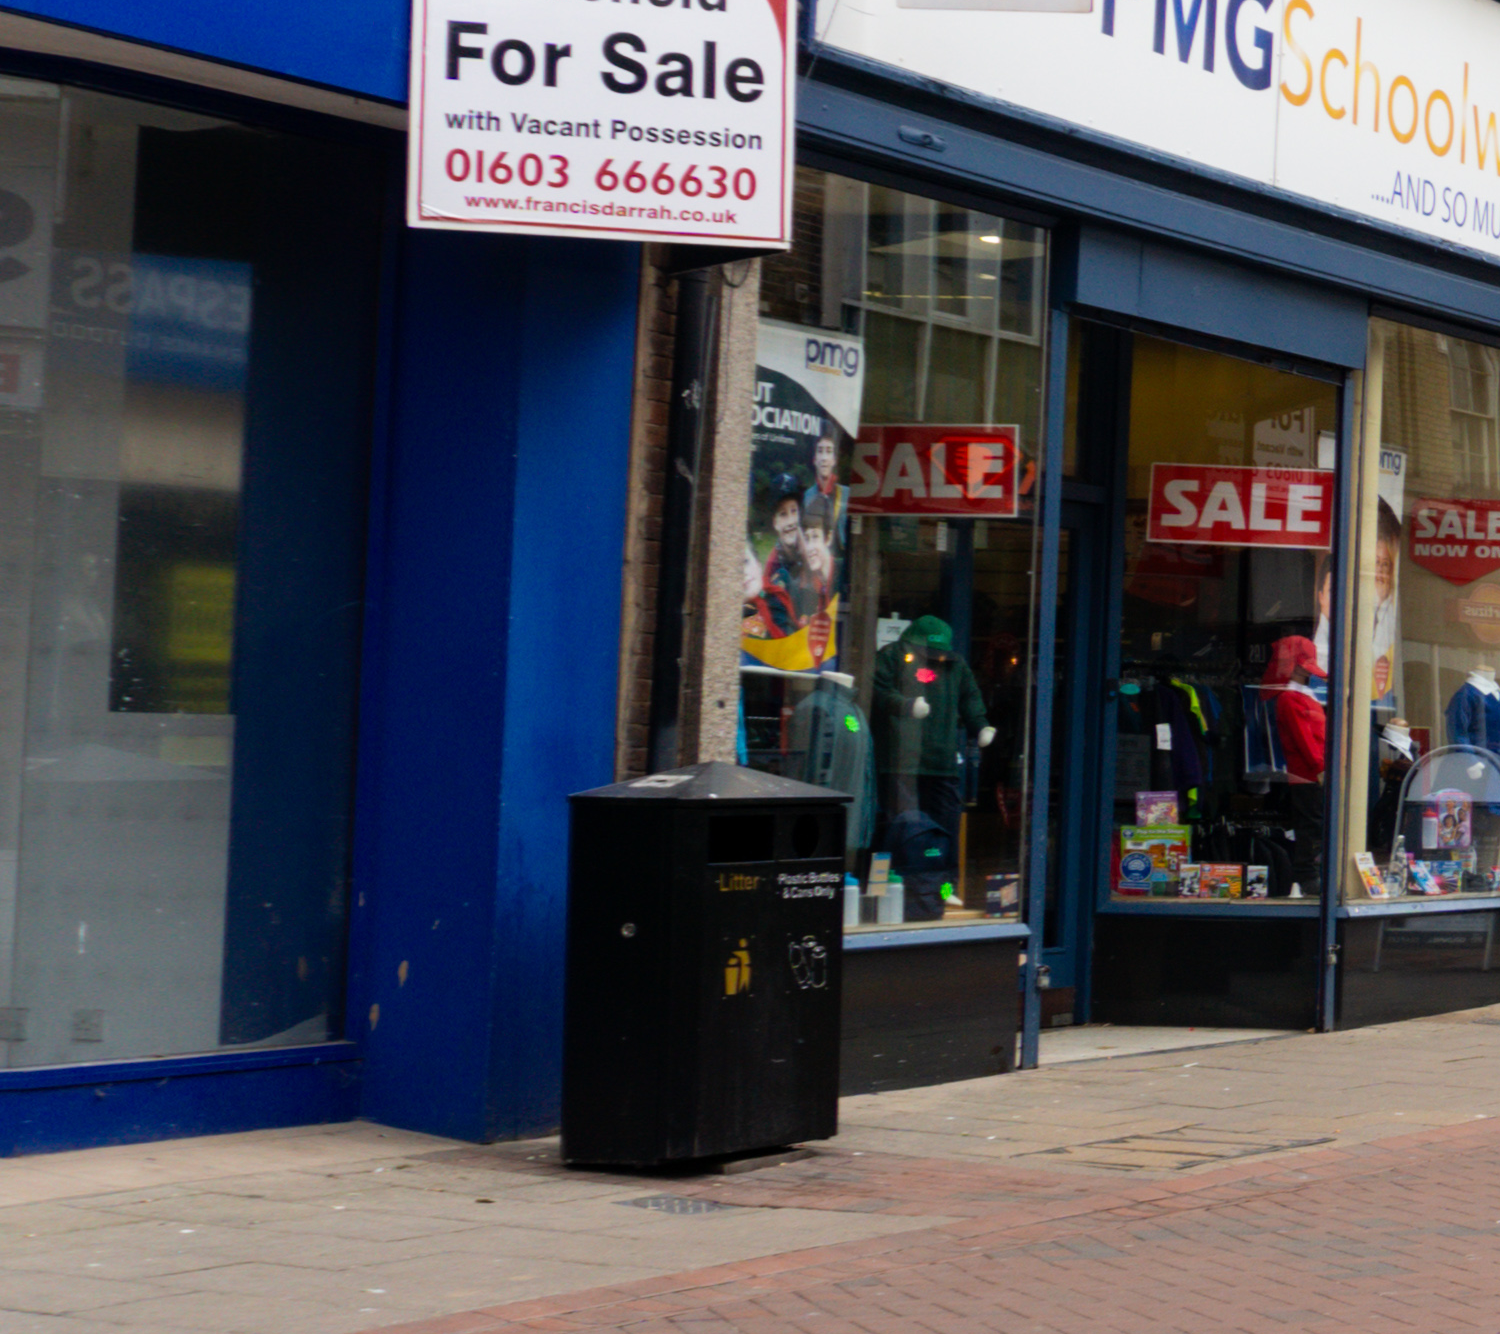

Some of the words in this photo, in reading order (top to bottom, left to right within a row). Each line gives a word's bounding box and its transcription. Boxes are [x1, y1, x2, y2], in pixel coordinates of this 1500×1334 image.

[445, 20, 572, 87] For
[600, 31, 765, 103] Sale
[445, 110, 500, 131] with
[511, 112, 601, 139] Vacant
[611, 120, 763, 149] Possession
[445, 148, 569, 188] 01603
[595, 158, 756, 201] 666630
[464, 195, 737, 224] www.francisdarrah.co.uk
[1442, 186, 1467, 227] SO
[806, 338, 859, 377] pmg
[850, 443, 1004, 499] SALE
[1160, 478, 1323, 533] SALE
[1414, 544, 1468, 557] NOW
[720, 873, 758, 892] Litter
